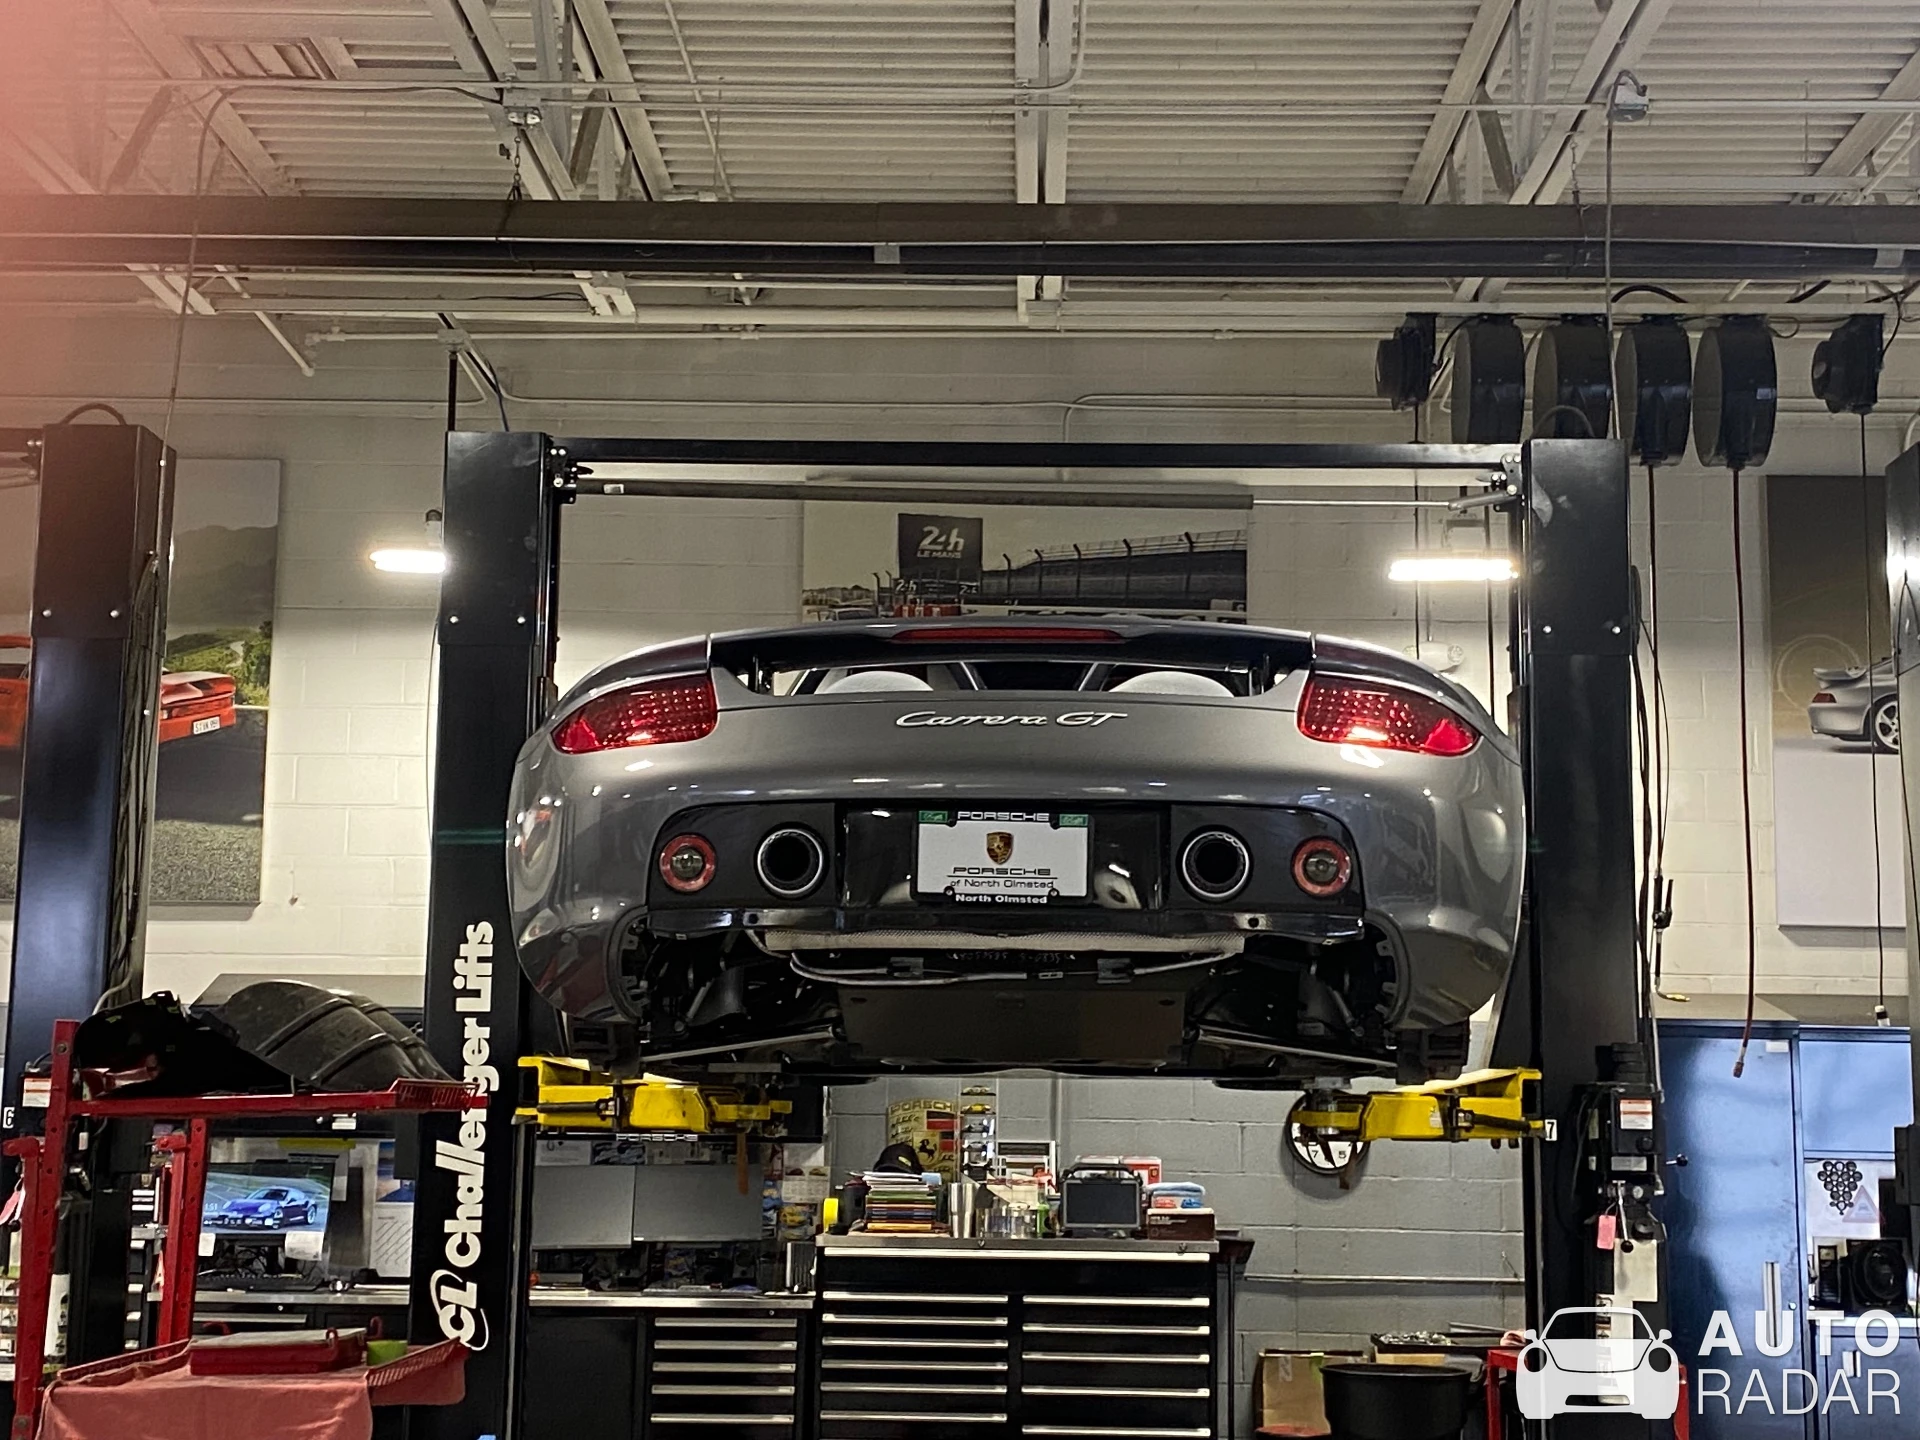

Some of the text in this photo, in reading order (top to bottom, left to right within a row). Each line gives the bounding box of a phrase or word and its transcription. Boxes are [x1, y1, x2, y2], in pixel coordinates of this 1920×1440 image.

[896, 711, 1128, 727] Carrera GT
[957, 811, 1050, 822] PORSCHE
[952, 866, 1052, 876] PORSCHE
[950, 878, 1054, 889] of North Olmsted
[955, 894, 1047, 904] North Olmsted
[453, 920, 494, 1012] Lifts
[889, 1100, 957, 1115] PORSCH
[1546, 1121, 1555, 1140] 7
[1311, 1150, 1347, 1159] 7 5
